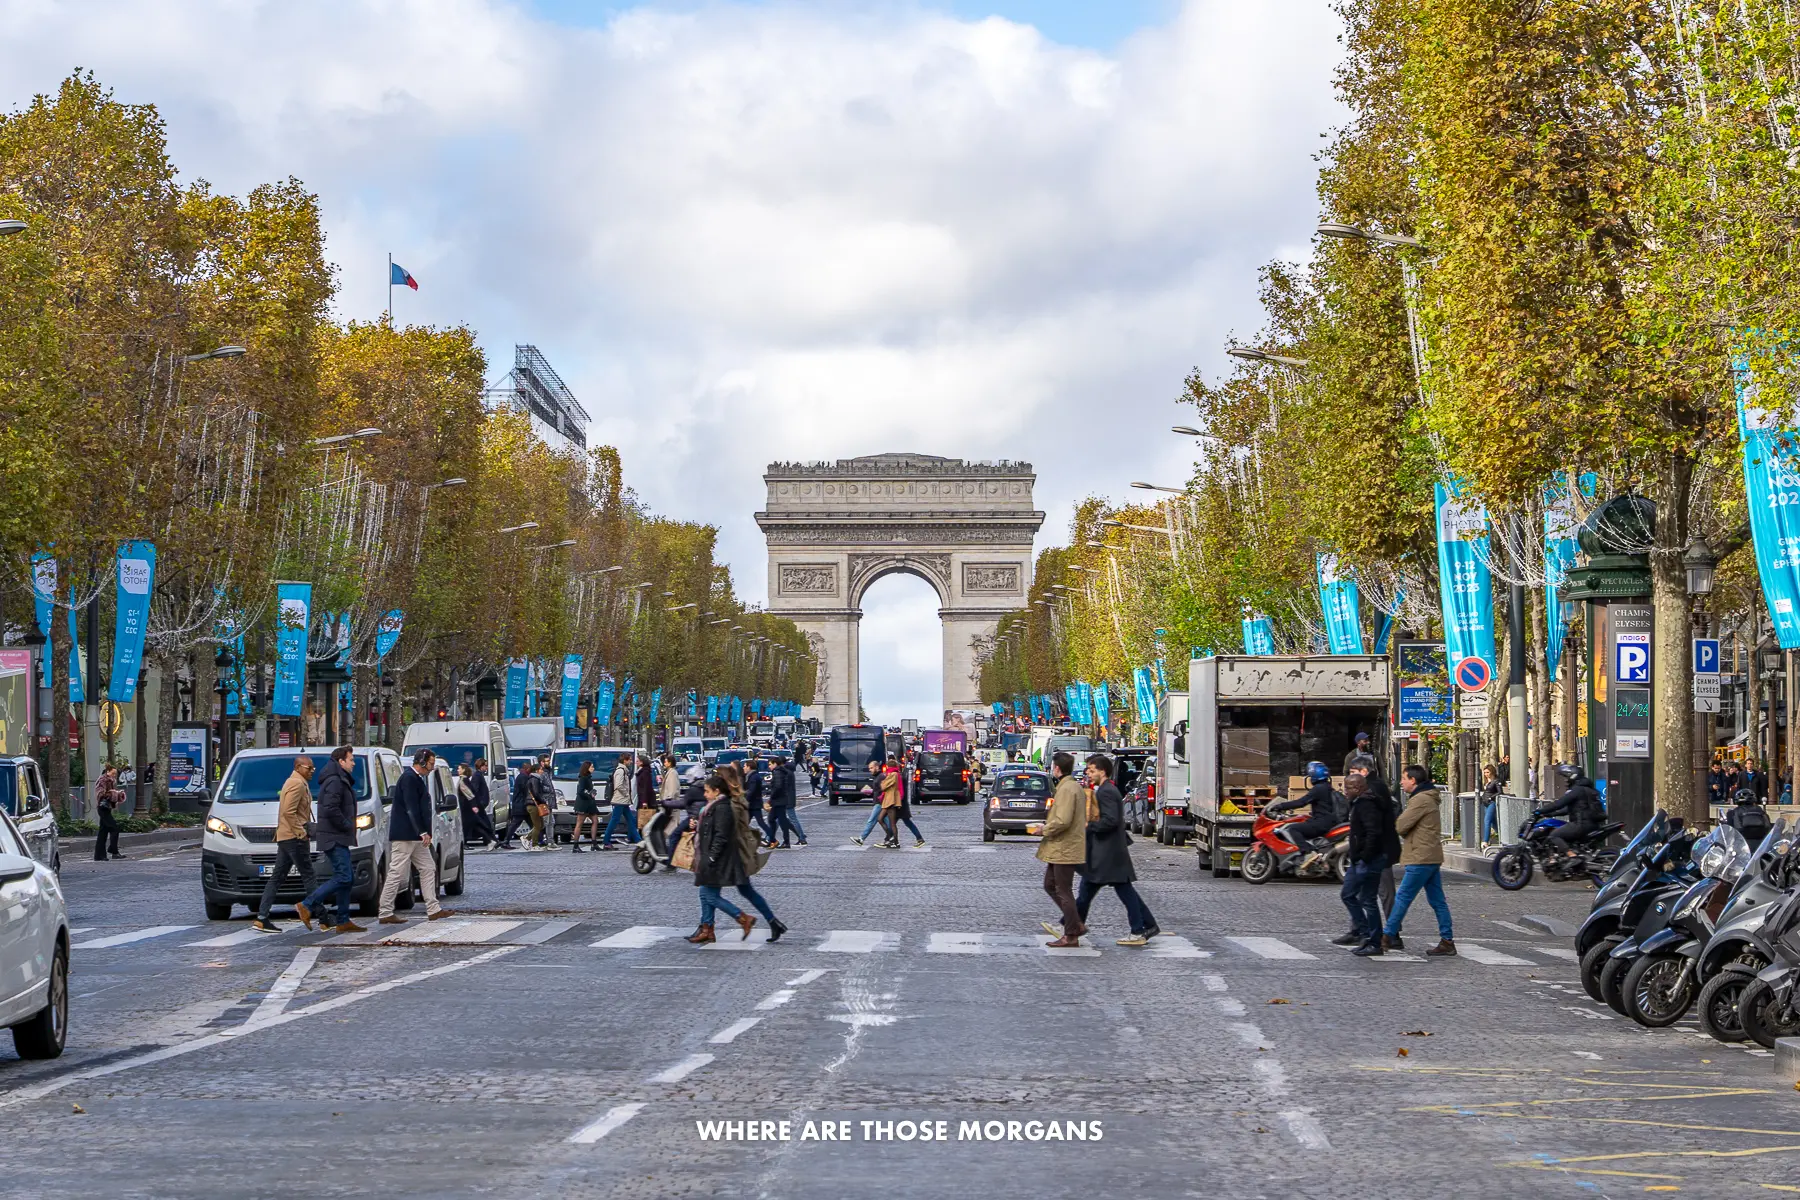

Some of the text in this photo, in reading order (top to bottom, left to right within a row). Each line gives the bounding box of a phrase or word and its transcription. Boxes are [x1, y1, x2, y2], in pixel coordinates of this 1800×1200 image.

[1767, 492, 1800, 508] 202
[1454, 561, 1476, 571] 9-12
[1454, 571, 1477, 582] NOV
[1600, 577, 1644, 585] SPECTACLES
[1614, 609, 1651, 617] CHAMPS
[1614, 620, 1651, 628] ELYSEES
[1701, 646, 1713, 667] P
[1619, 646, 1647, 679] P
[1696, 685, 1720, 694] ÉLYSÉES
[1617, 702, 1649, 717] 24/24
